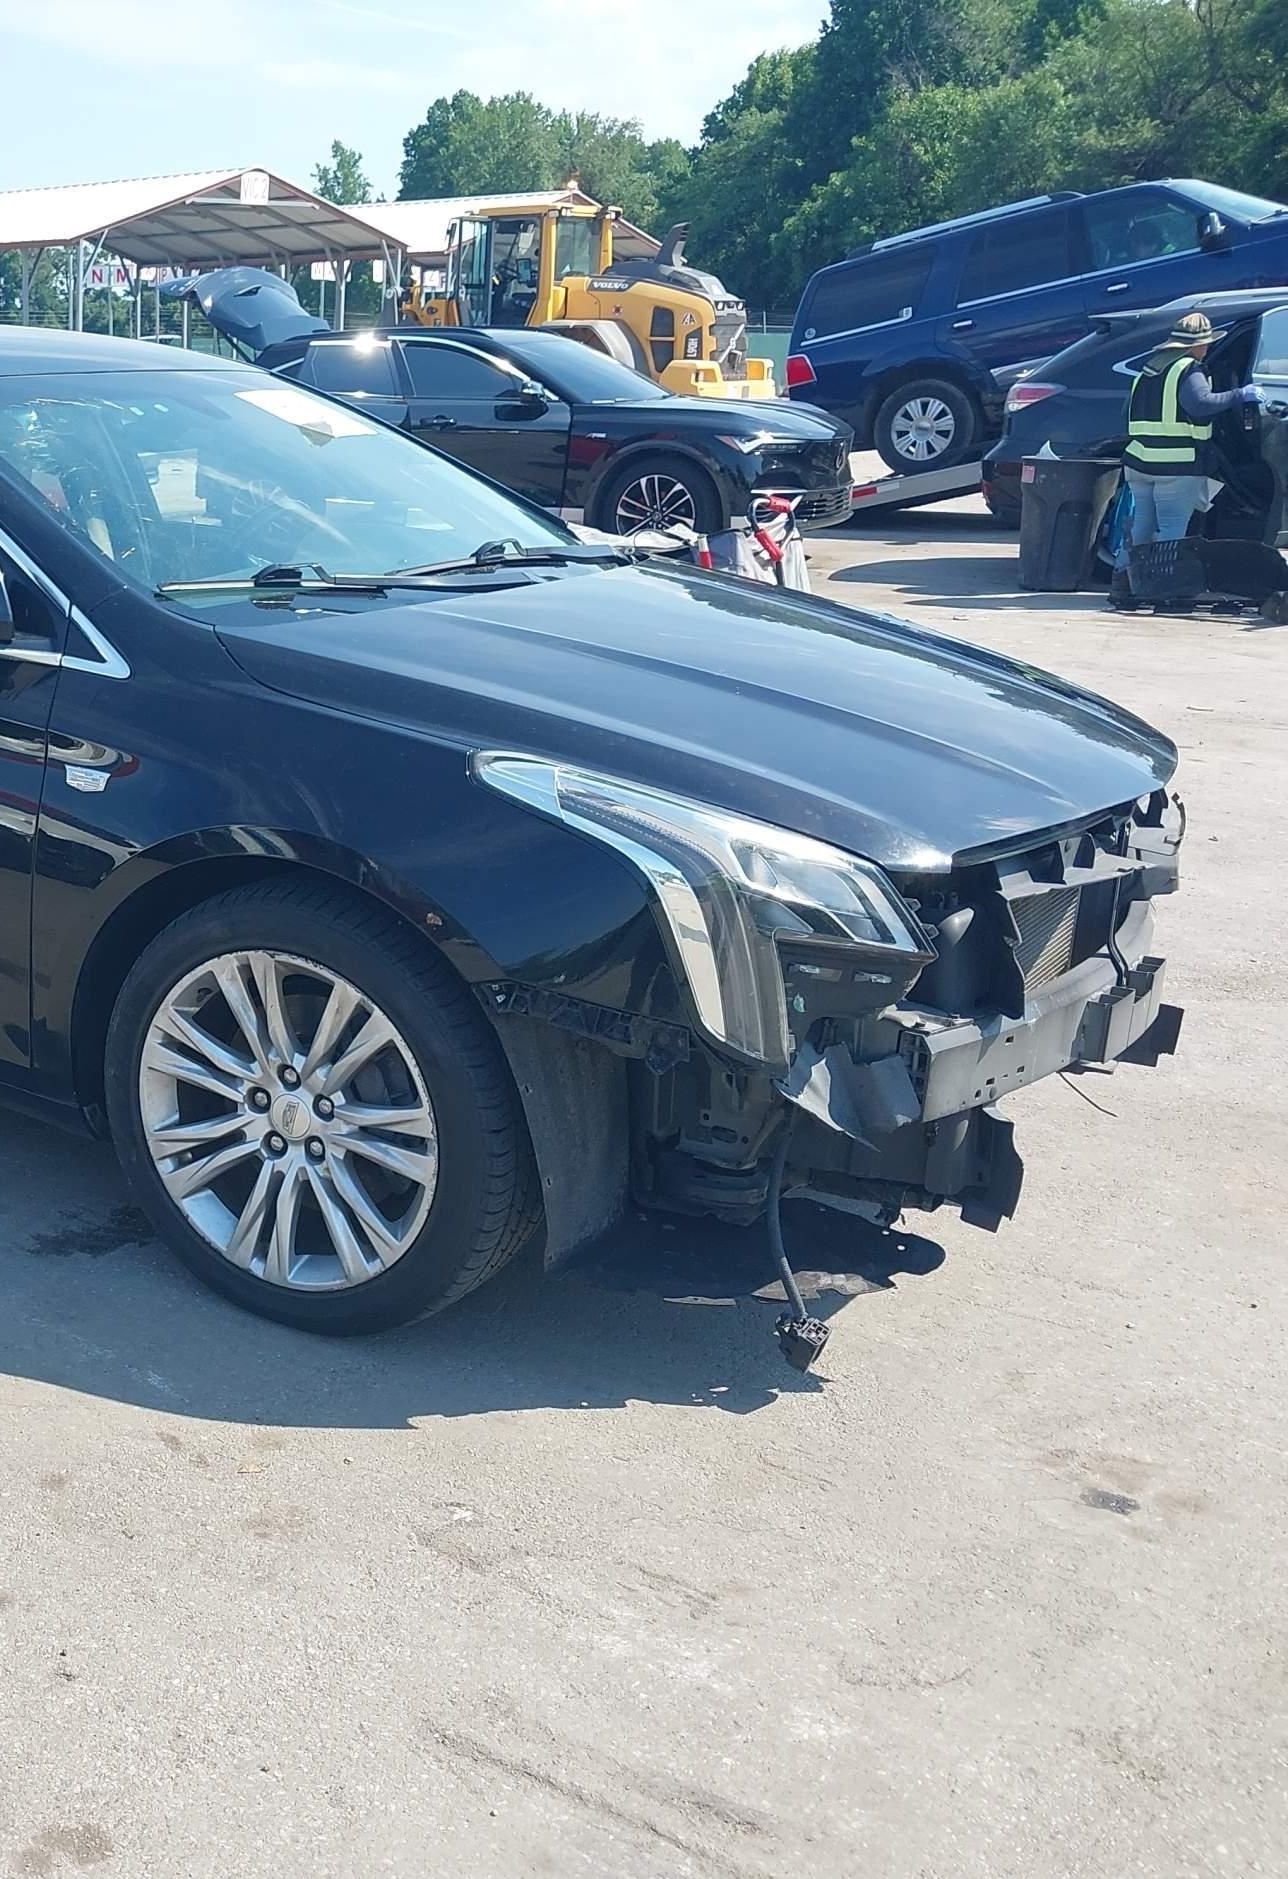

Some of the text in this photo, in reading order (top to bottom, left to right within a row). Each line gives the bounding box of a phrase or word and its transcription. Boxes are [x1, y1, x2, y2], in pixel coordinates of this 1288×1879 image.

[92, 268, 103, 284] N
[592, 280, 629, 290] VOLVO
[686, 337, 699, 358] L90H
